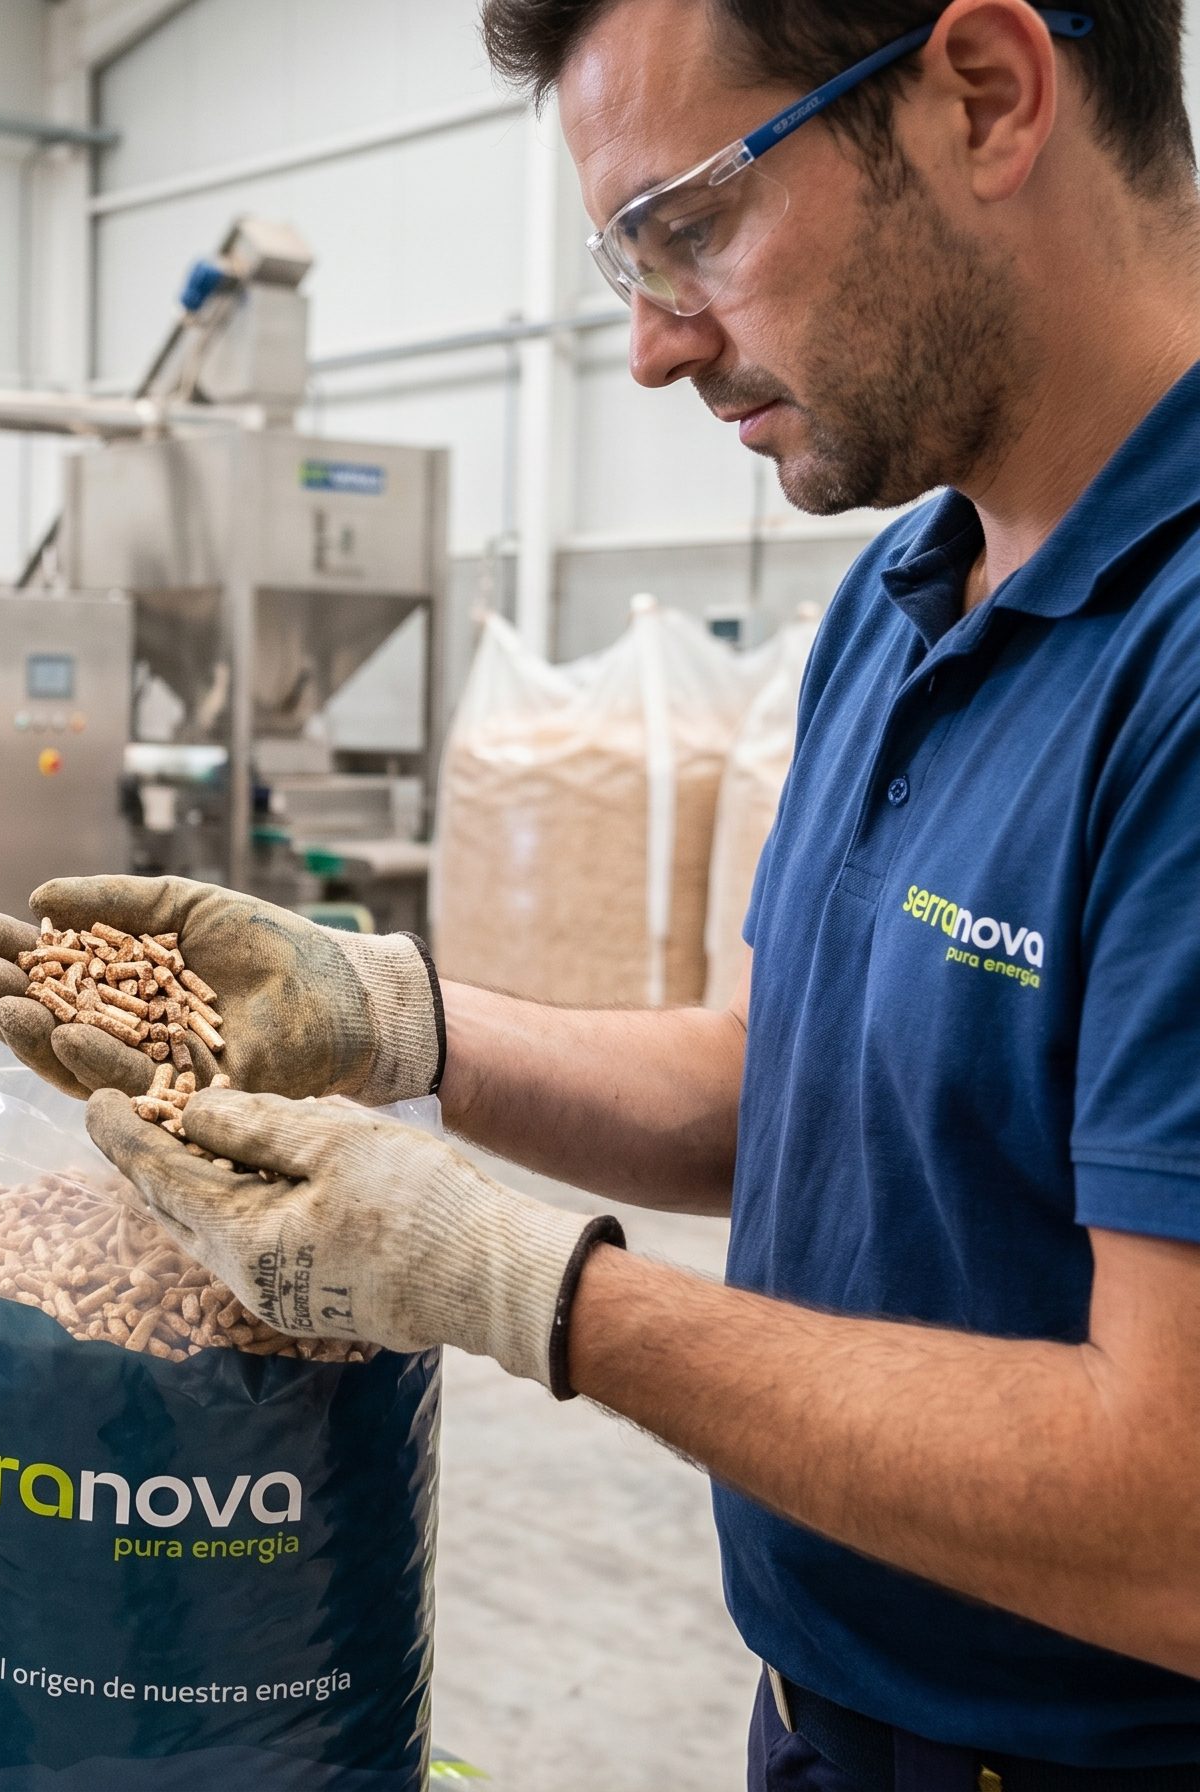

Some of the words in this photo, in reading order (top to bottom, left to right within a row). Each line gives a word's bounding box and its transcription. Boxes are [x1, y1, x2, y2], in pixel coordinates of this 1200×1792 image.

[902, 885, 1044, 968] serranova
[945, 947, 980, 969] pura
[114, 1537, 183, 1562] pura
[192, 1531, 299, 1564] energia
[13, 1667, 95, 1697] origen
[102, 1676, 136, 1699] de
[144, 1682, 248, 1703] nuestra
[255, 1668, 351, 1701] energía
